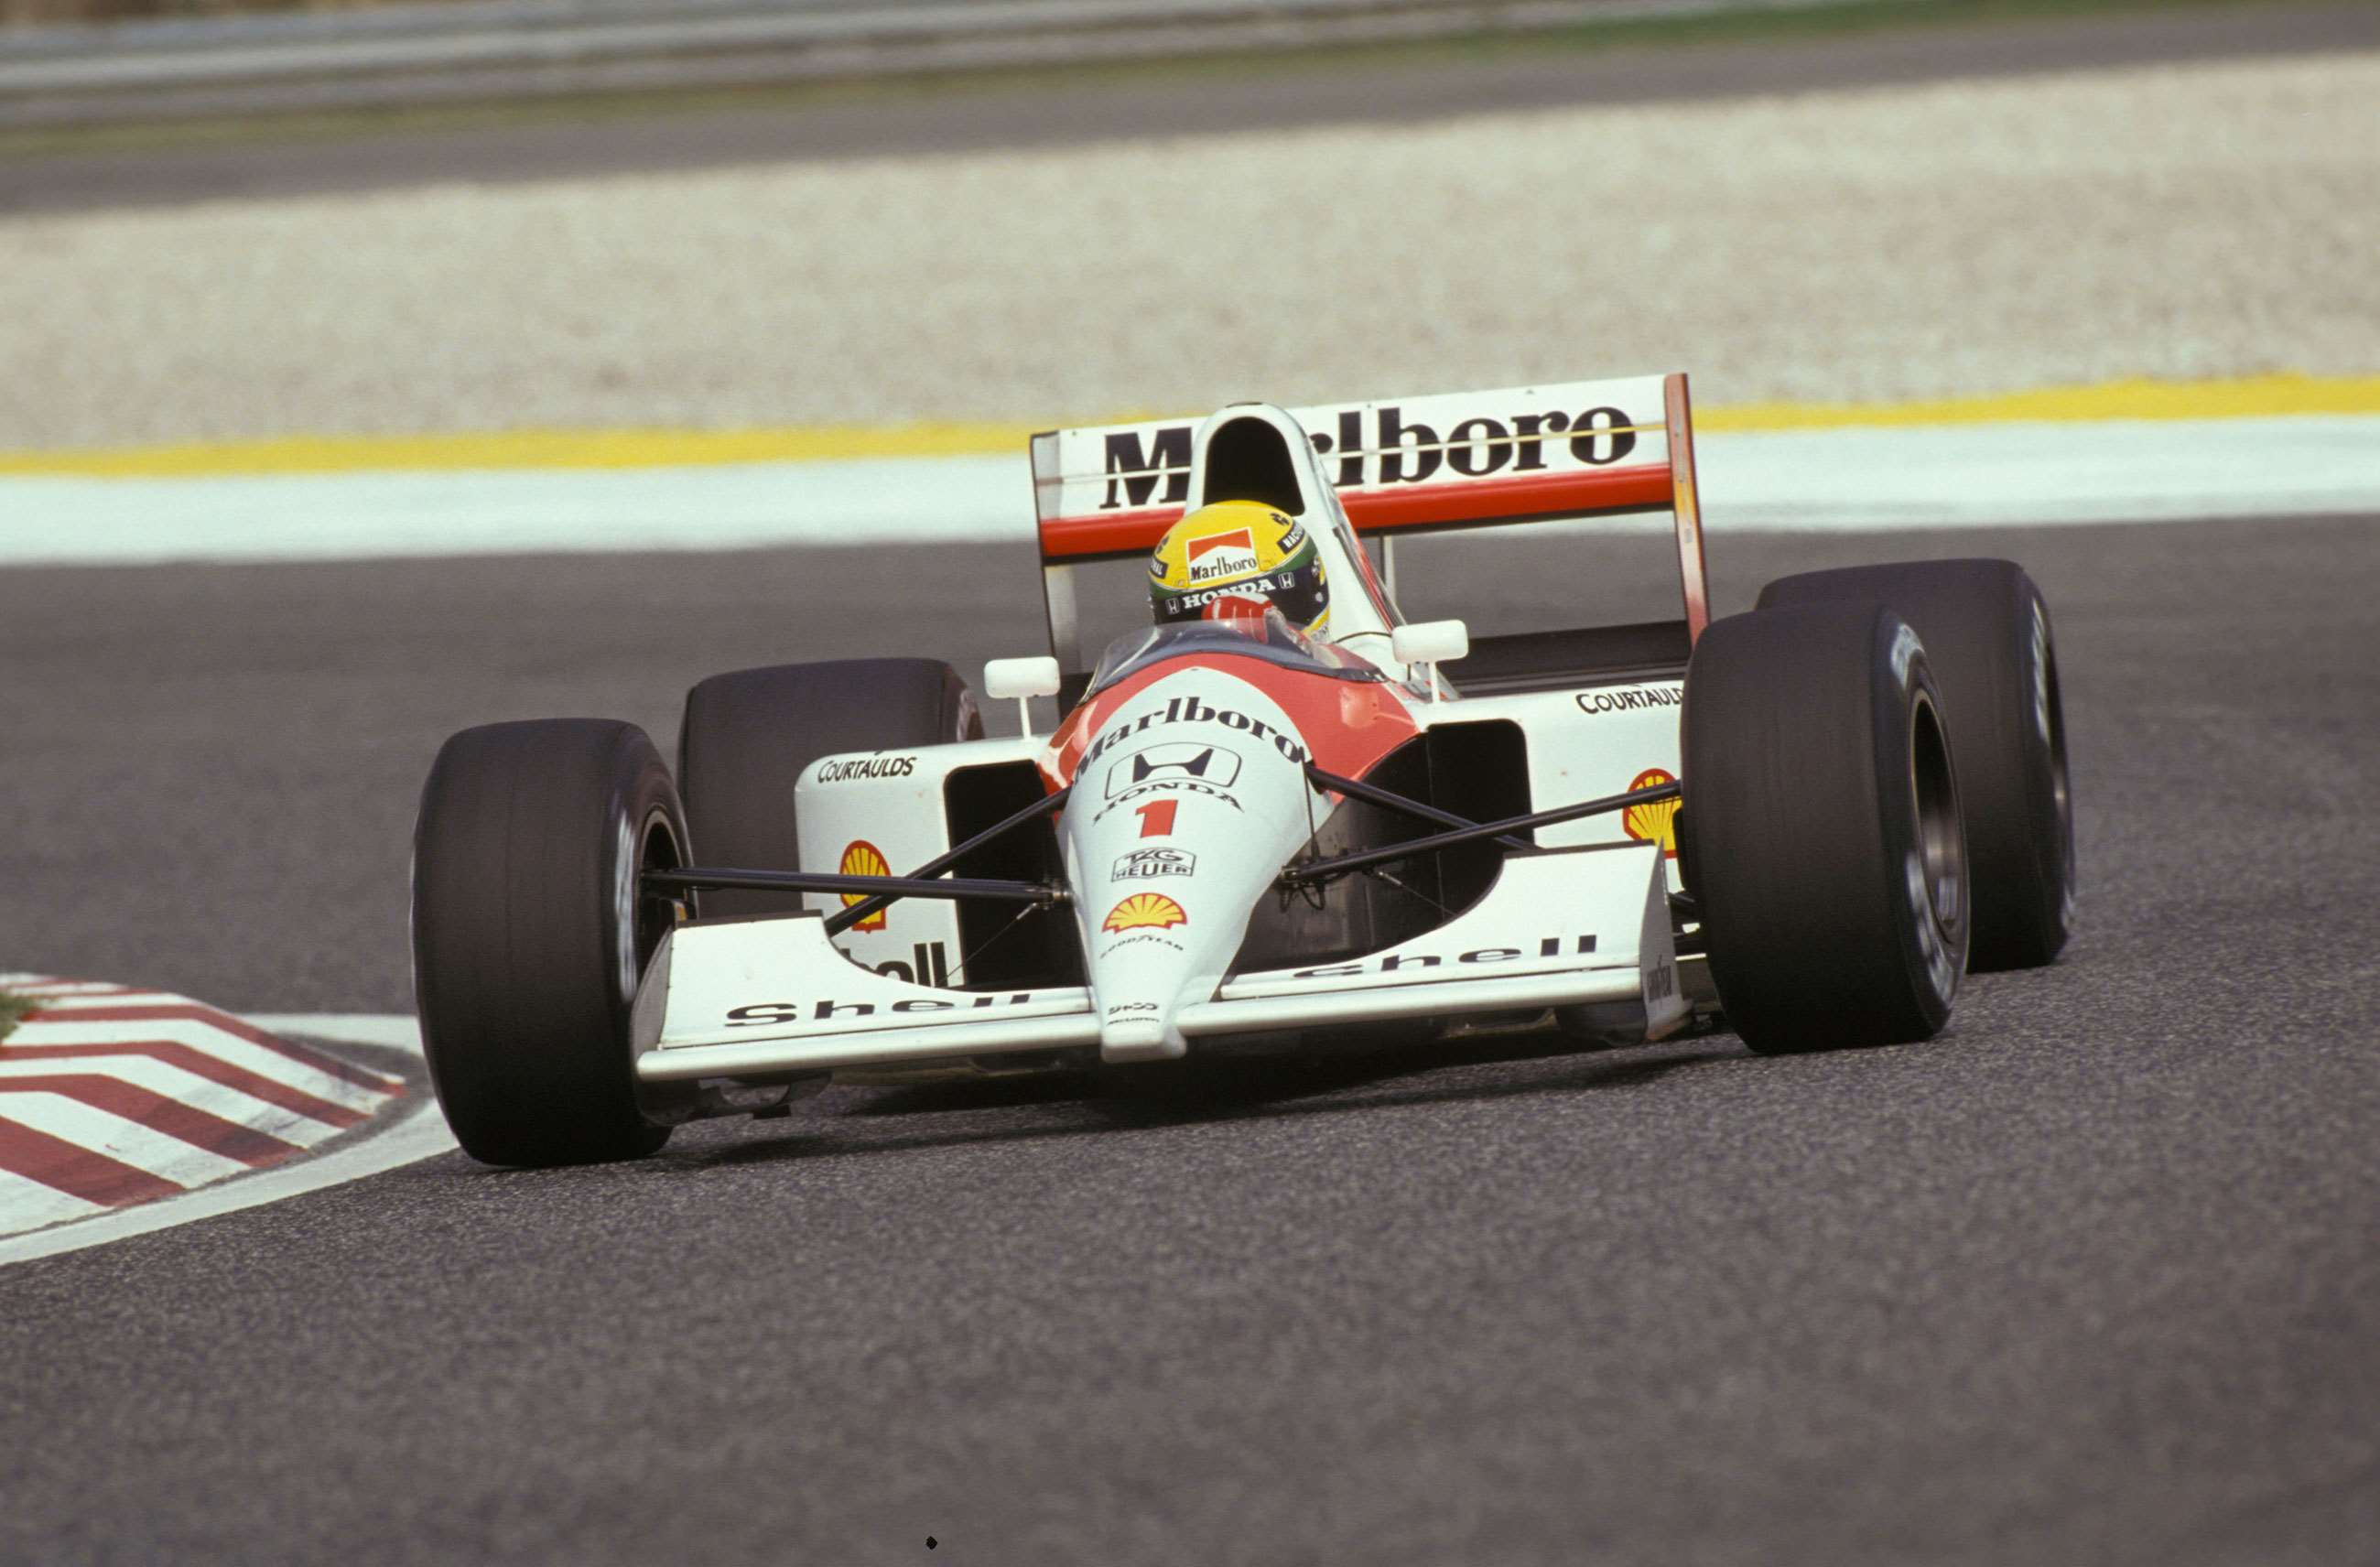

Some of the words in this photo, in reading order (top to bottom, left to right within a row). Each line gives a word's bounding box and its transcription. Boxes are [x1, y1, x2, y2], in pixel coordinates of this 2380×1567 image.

[1099, 405, 1637, 510] Mlboro
[1191, 556, 1257, 581] Marlboro
[1575, 687, 1684, 715] COURTAULD
[1074, 696, 1304, 786] Marlboro
[817, 756, 917, 784] COURTAULDS
[1094, 781, 1245, 827] HONDA
[1135, 799, 1178, 838] 1
[1115, 863, 1188, 878] HEUER
